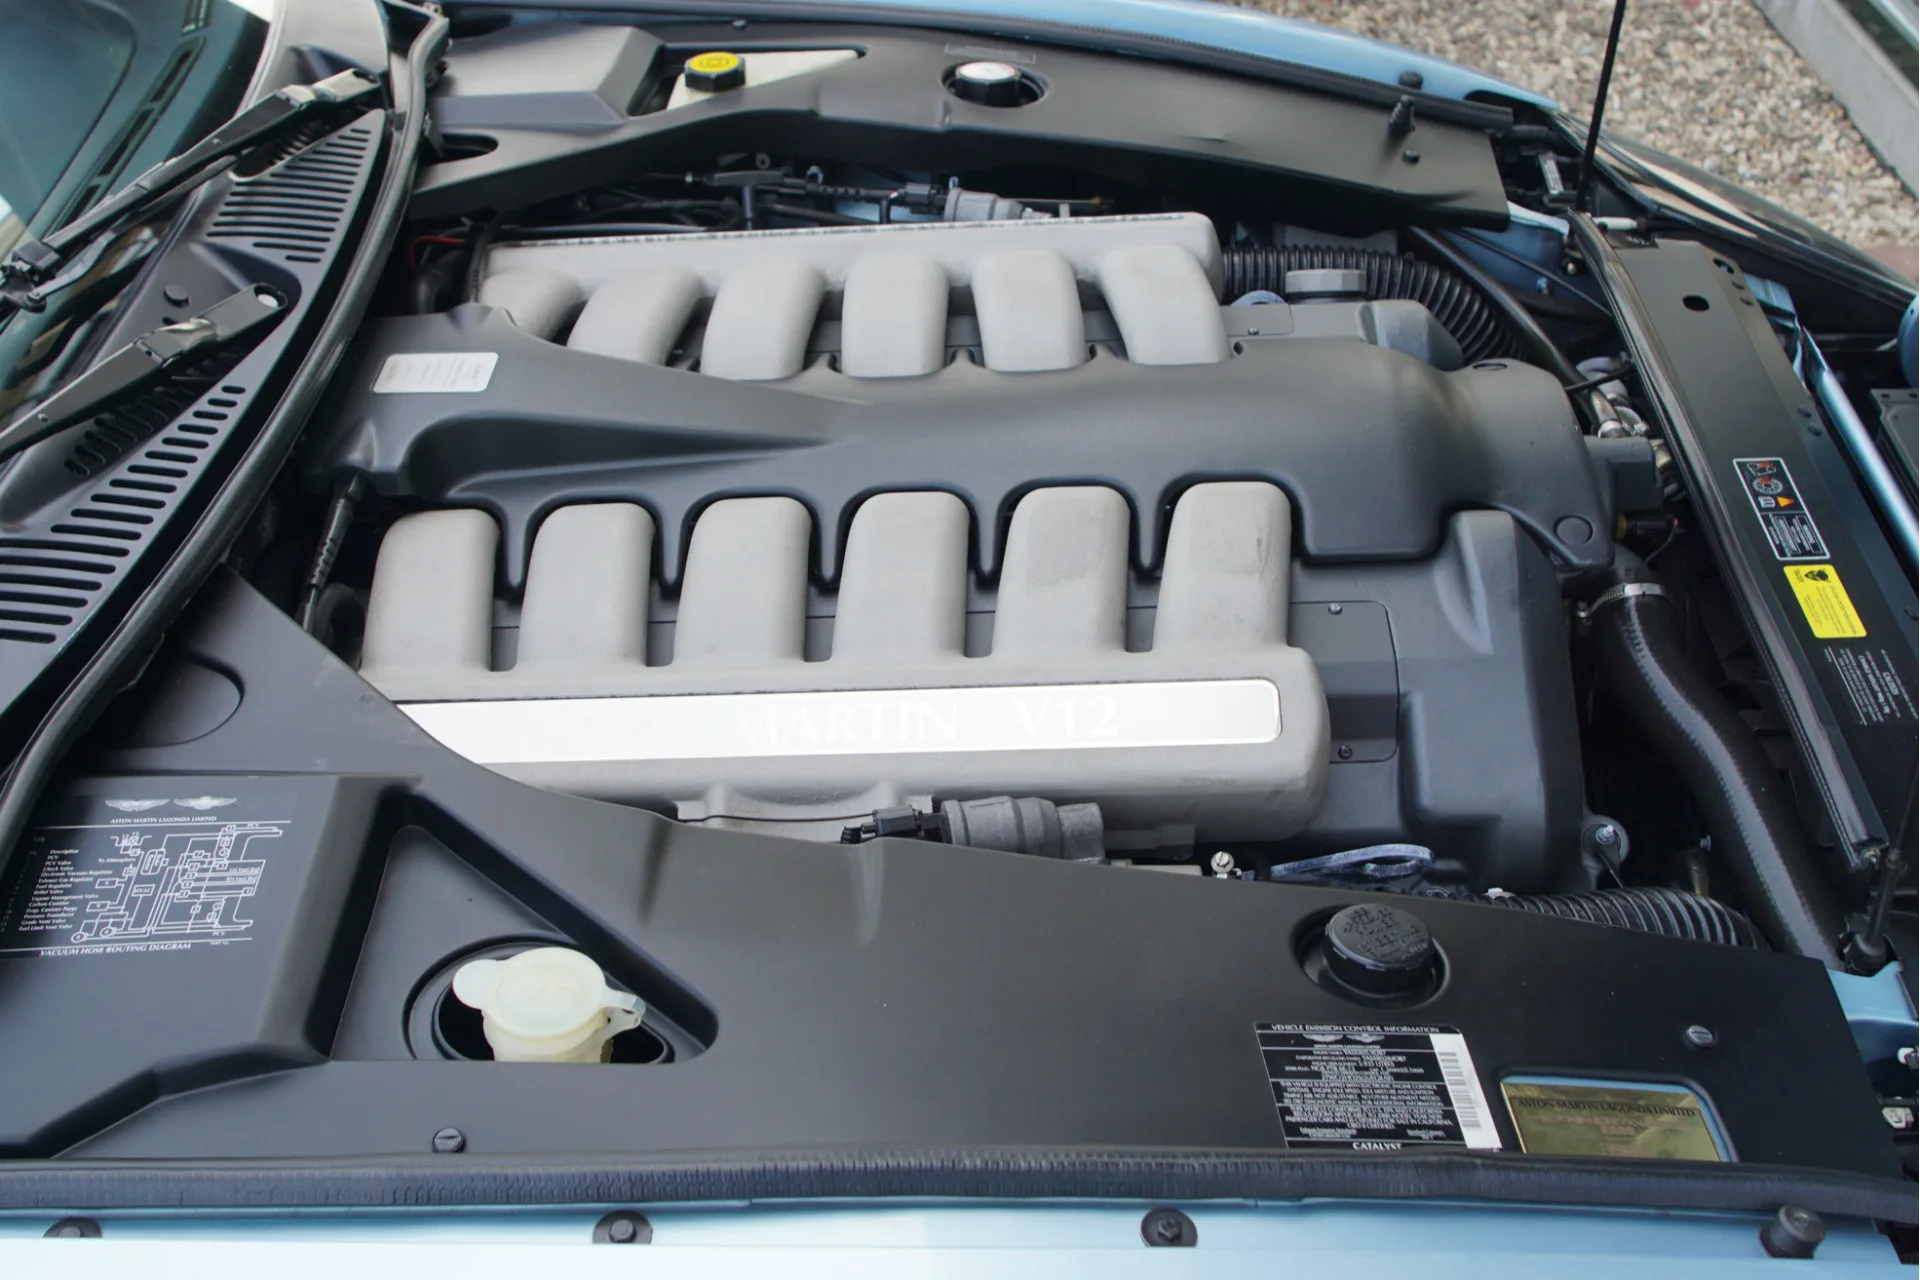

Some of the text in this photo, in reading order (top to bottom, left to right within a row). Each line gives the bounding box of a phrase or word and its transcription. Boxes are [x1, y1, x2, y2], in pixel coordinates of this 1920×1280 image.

[1012, 696, 1120, 742] V12
[39, 943, 191, 957] VACUUM HOSE ROUTING DIAGRAM
[1305, 1024, 1343, 1032] EMISSION
[1518, 1099, 1695, 1117] ASTON MARTIN LAGONDA LIMITED
[1352, 1142, 1403, 1151] CATALYST
